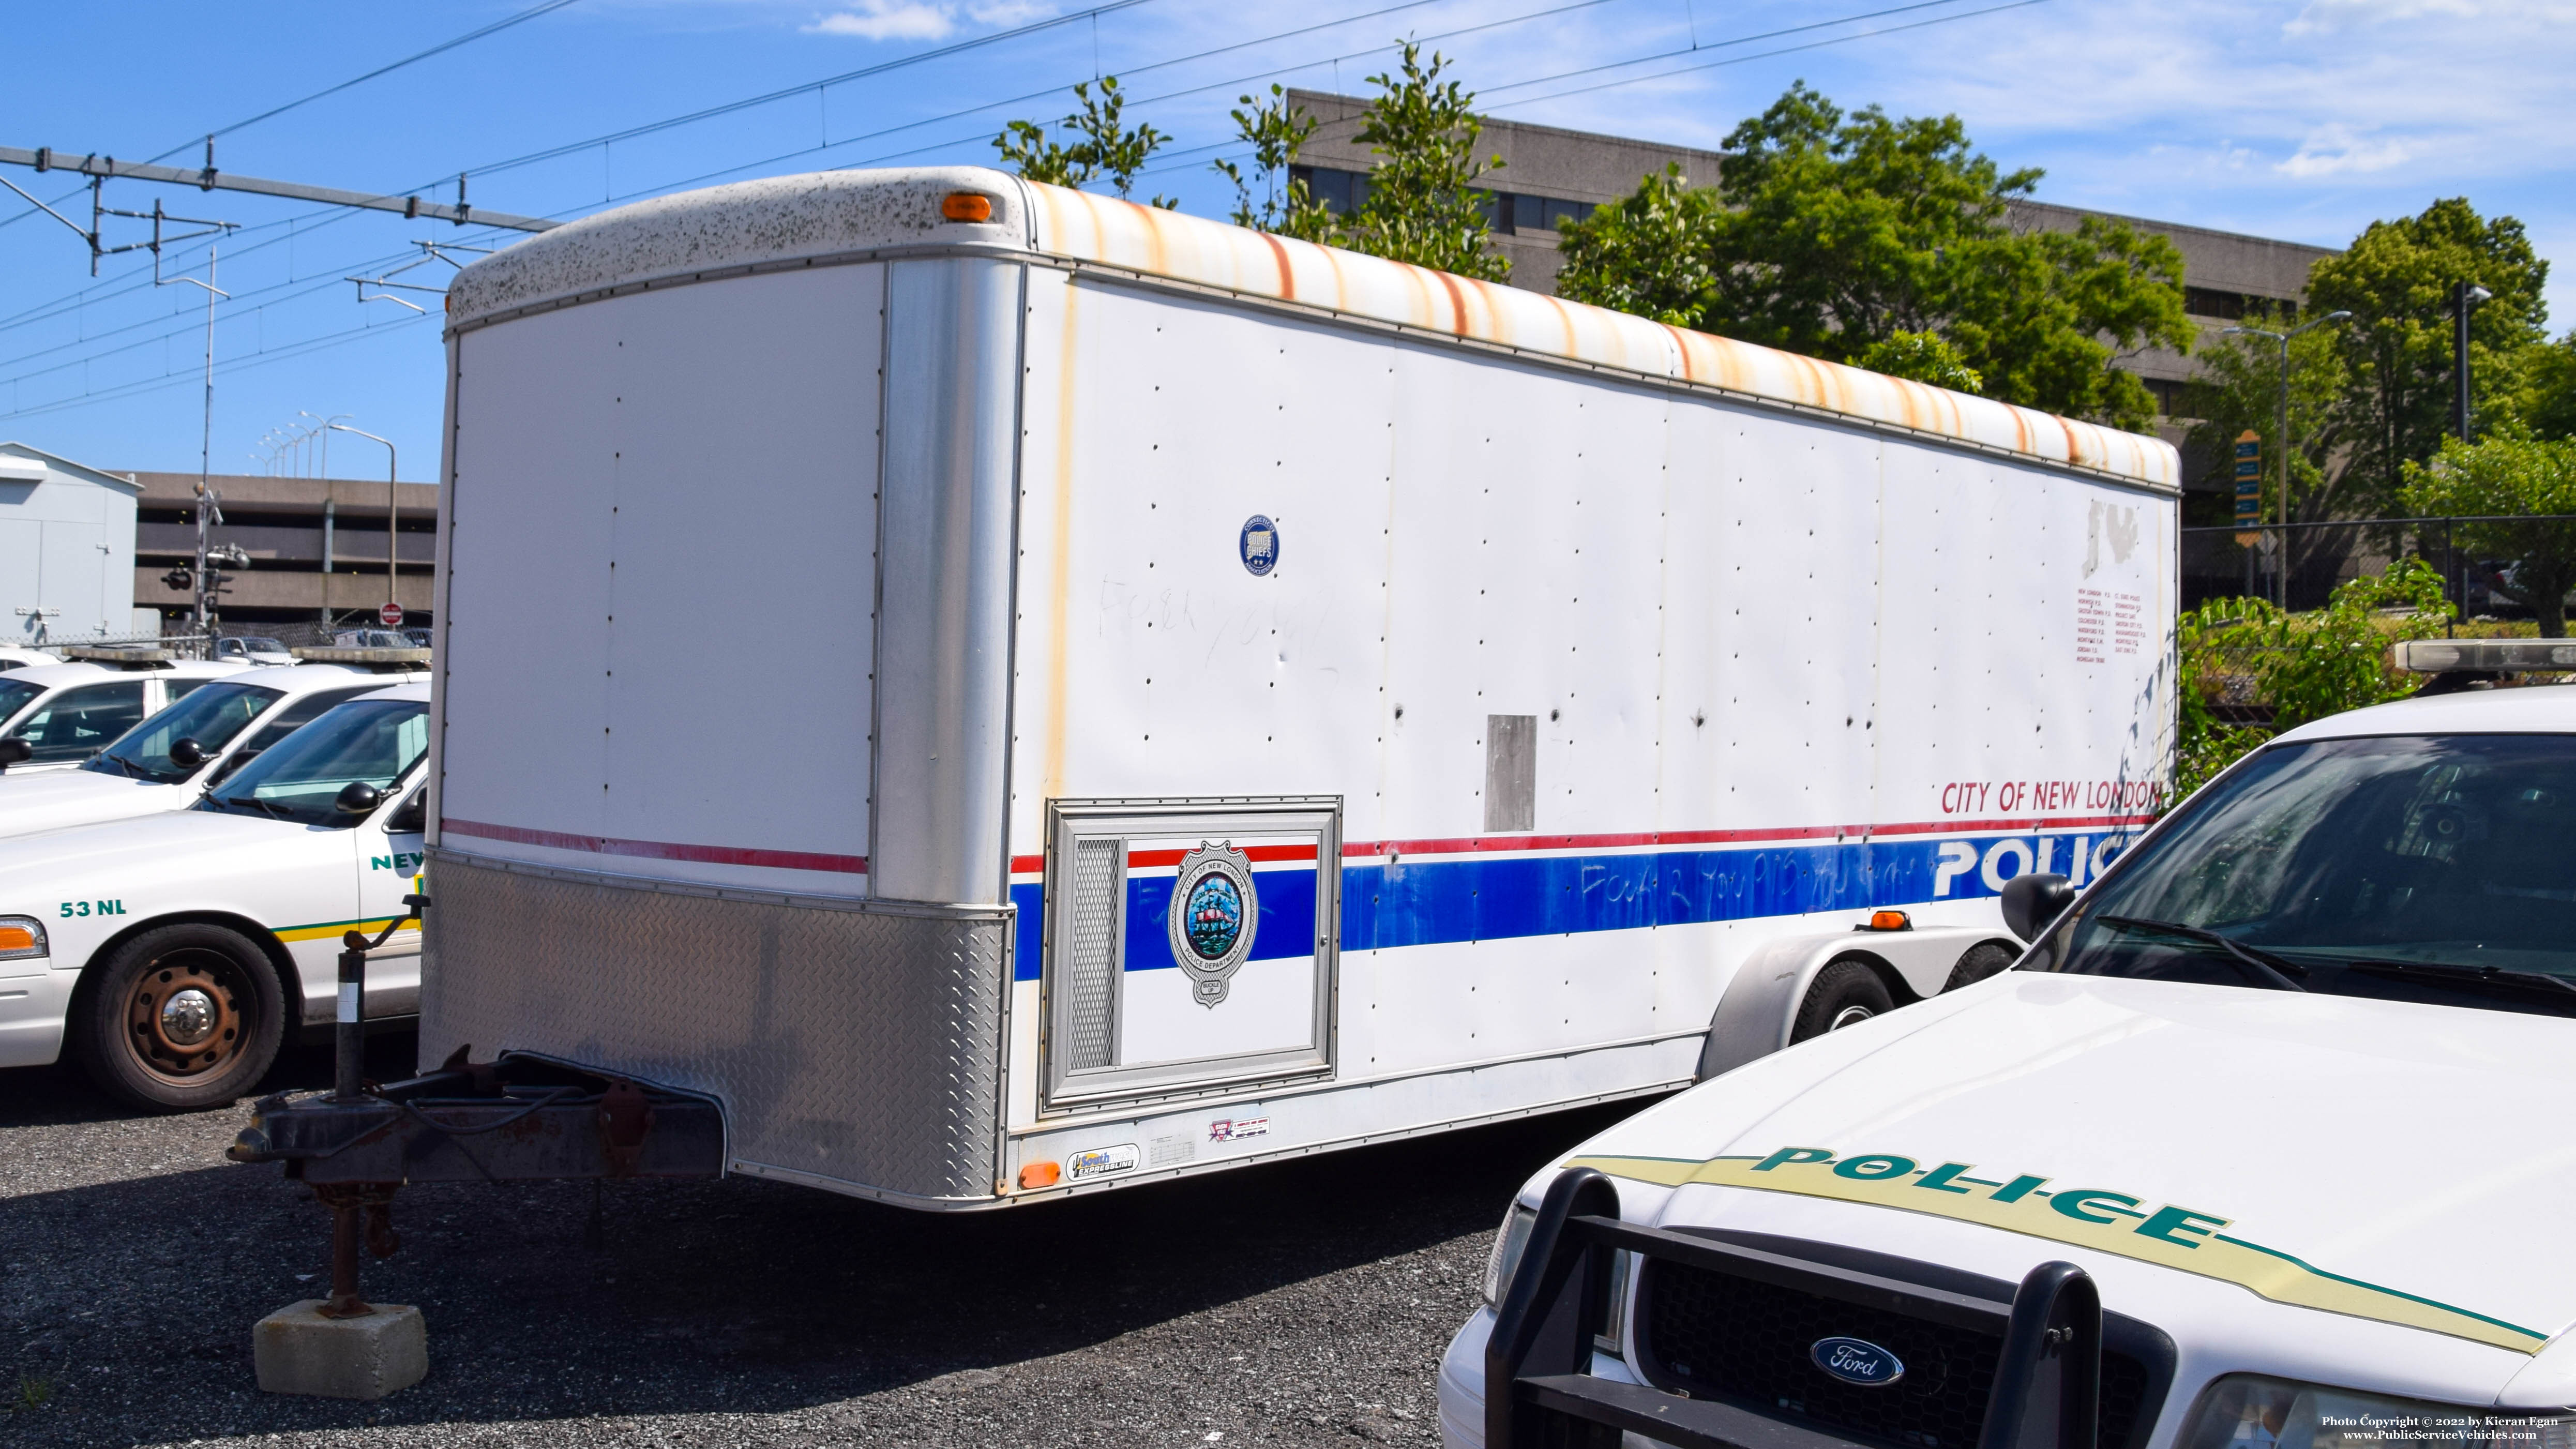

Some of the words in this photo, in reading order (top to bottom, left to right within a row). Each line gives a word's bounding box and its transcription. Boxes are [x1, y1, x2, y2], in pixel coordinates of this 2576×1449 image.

[1247, 534, 1272, 546] POLICE
[1247, 546, 1271, 557] CHIEFS
[1942, 782, 1991, 814] CITY
[1999, 781, 2027, 811] OF
[2033, 781, 2081, 811] NEW
[2086, 780, 2163, 810] LONDON
[1185, 872, 1196, 889] CITY
[1198, 866, 1206, 874] OF
[1224, 865, 1244, 888] LONDON
[1933, 835, 2144, 897] POLIC
[60, 901, 91, 918] 53
[97, 899, 127, 915] NL
[1185, 947, 1203, 967] POLICE
[1204, 944, 1240, 969] DEPARTMENT
[1079, 1160, 1133, 1175] EXPRESSLINE
[1081, 1150, 1134, 1167] Southwest
[1750, 1146, 2232, 1249] POLICE
[1830, 1345, 1878, 1376] Ford
